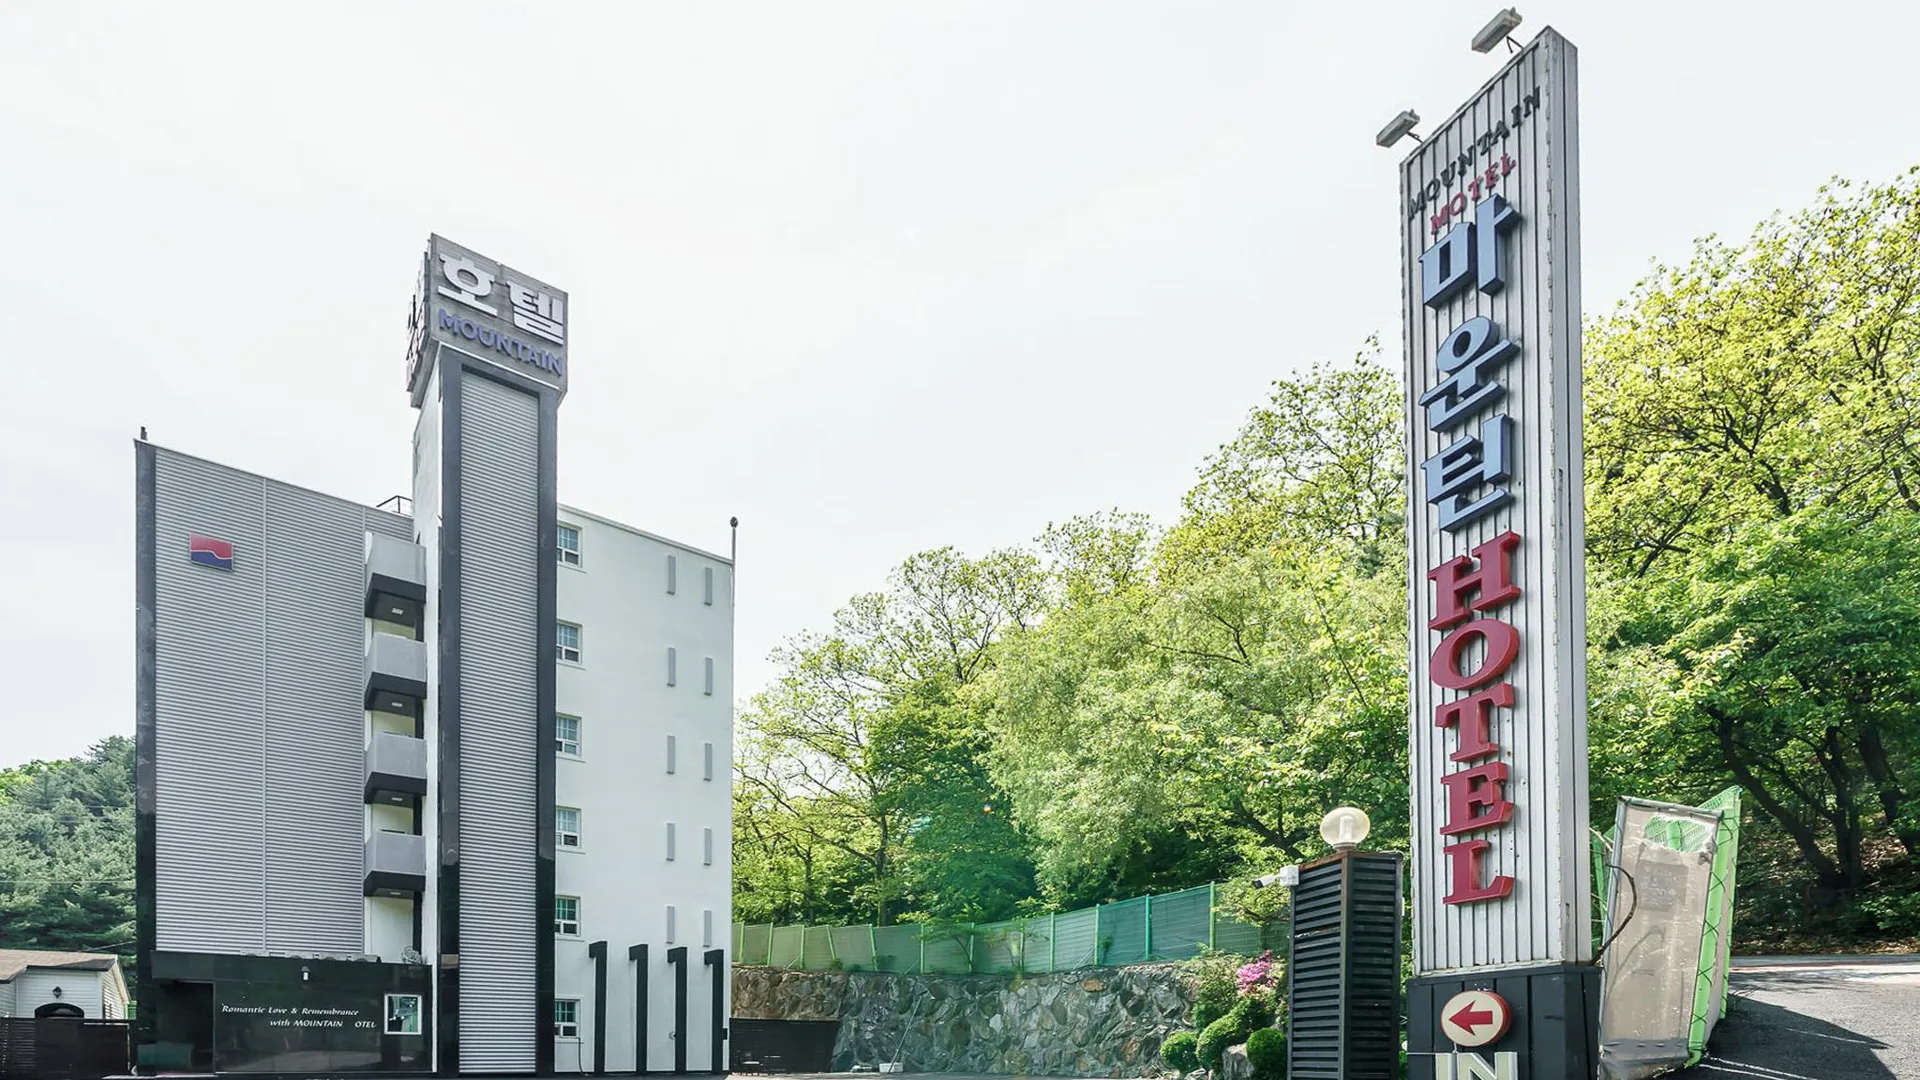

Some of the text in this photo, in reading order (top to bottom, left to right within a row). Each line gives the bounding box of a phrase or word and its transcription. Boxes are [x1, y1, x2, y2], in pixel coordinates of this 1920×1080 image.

[1407, 85, 1541, 221] MOUNTAIN
[1430, 152, 1516, 235] MOTEL
[437, 252, 564, 347] 호텔
[438, 307, 563, 377] MOUNTAIN
[1418, 192, 1520, 532] 마운틴
[1427, 530, 1522, 906] HOTEL
[221, 1003, 359, 1017] Romantic Love & Remembrance
[270, 1018, 291, 1027] with
[292, 1019, 344, 1028] MOUNTAIN
[1435, 1051, 1518, 1080] IN
